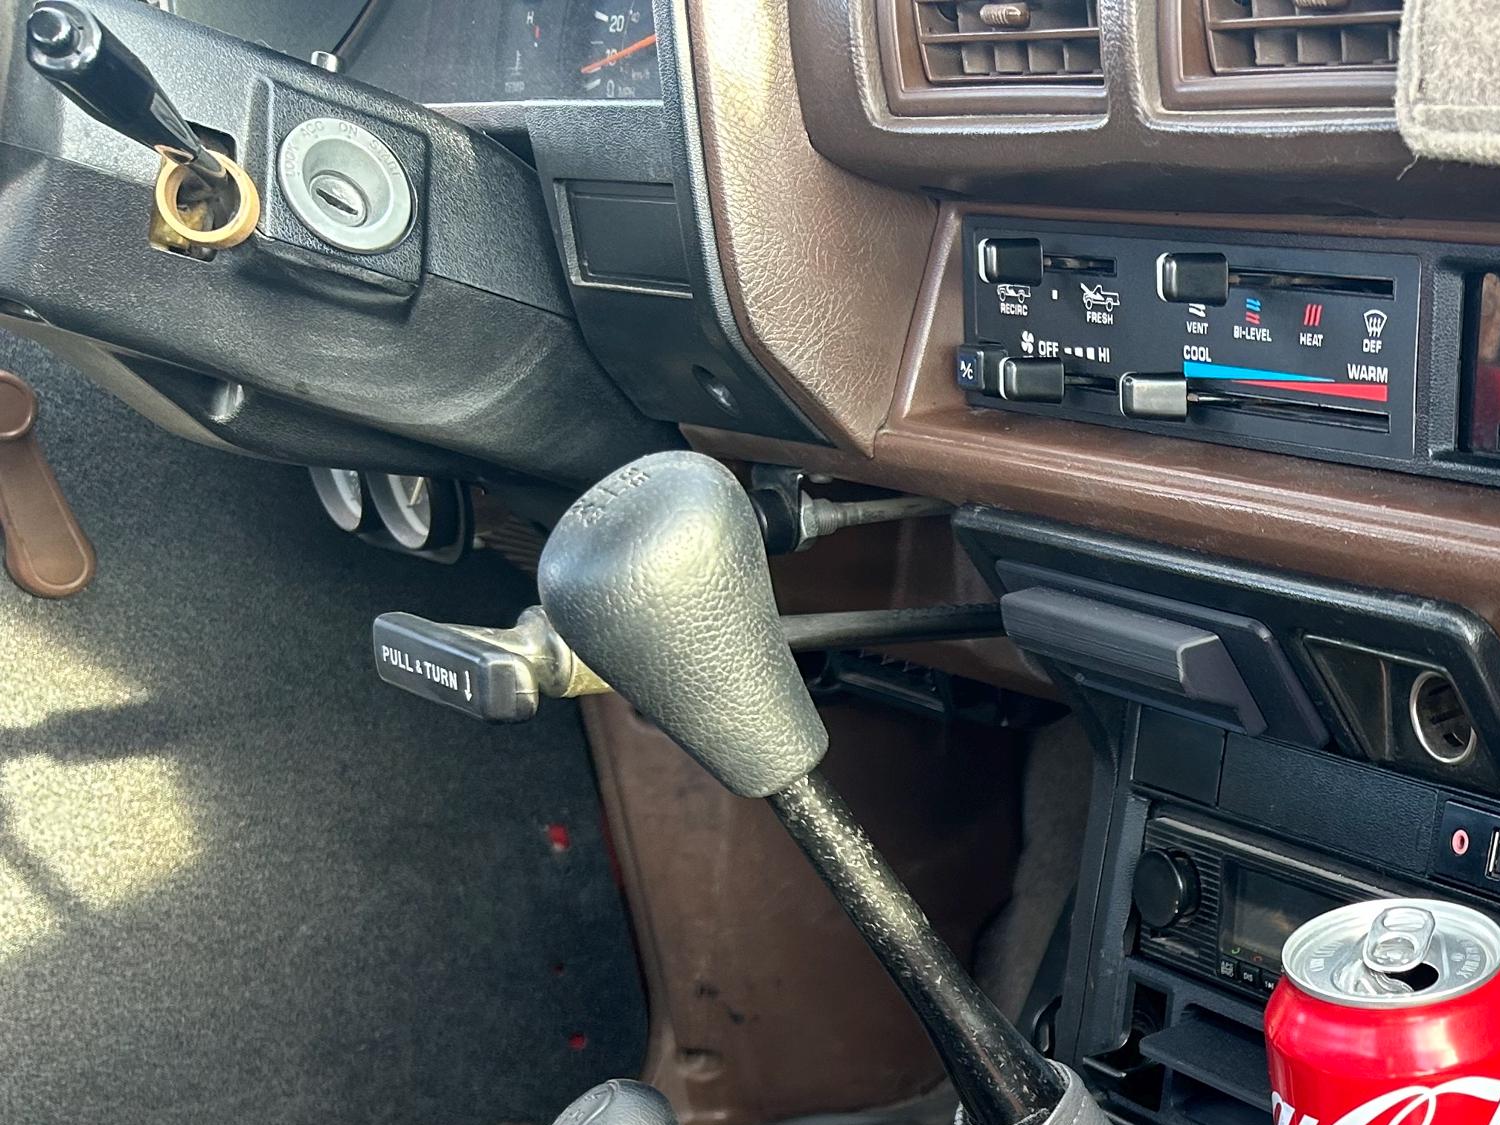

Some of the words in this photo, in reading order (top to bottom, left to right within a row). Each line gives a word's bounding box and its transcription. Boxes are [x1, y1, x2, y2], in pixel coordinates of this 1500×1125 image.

[609, 15, 625, 32] 20
[339, 122, 358, 137] ON
[1000, 303, 1028, 316] RECIRC
[1086, 311, 1113, 325] FRESH
[1186, 321, 1208, 335] VENT
[1233, 326, 1272, 343] BI-LEVEL
[1299, 333, 1323, 347] HEAT
[1362, 339, 1382, 354] DEF
[1038, 341, 1059, 358] OFF
[1099, 347, 1110, 363] HI
[1183, 345, 1212, 362] COOL
[960, 360, 973, 380] A/C
[1347, 364, 1389, 384] WARM
[382, 645, 414, 673] PULL
[415, 659, 423, 675] &
[424, 661, 458, 691] TURN
